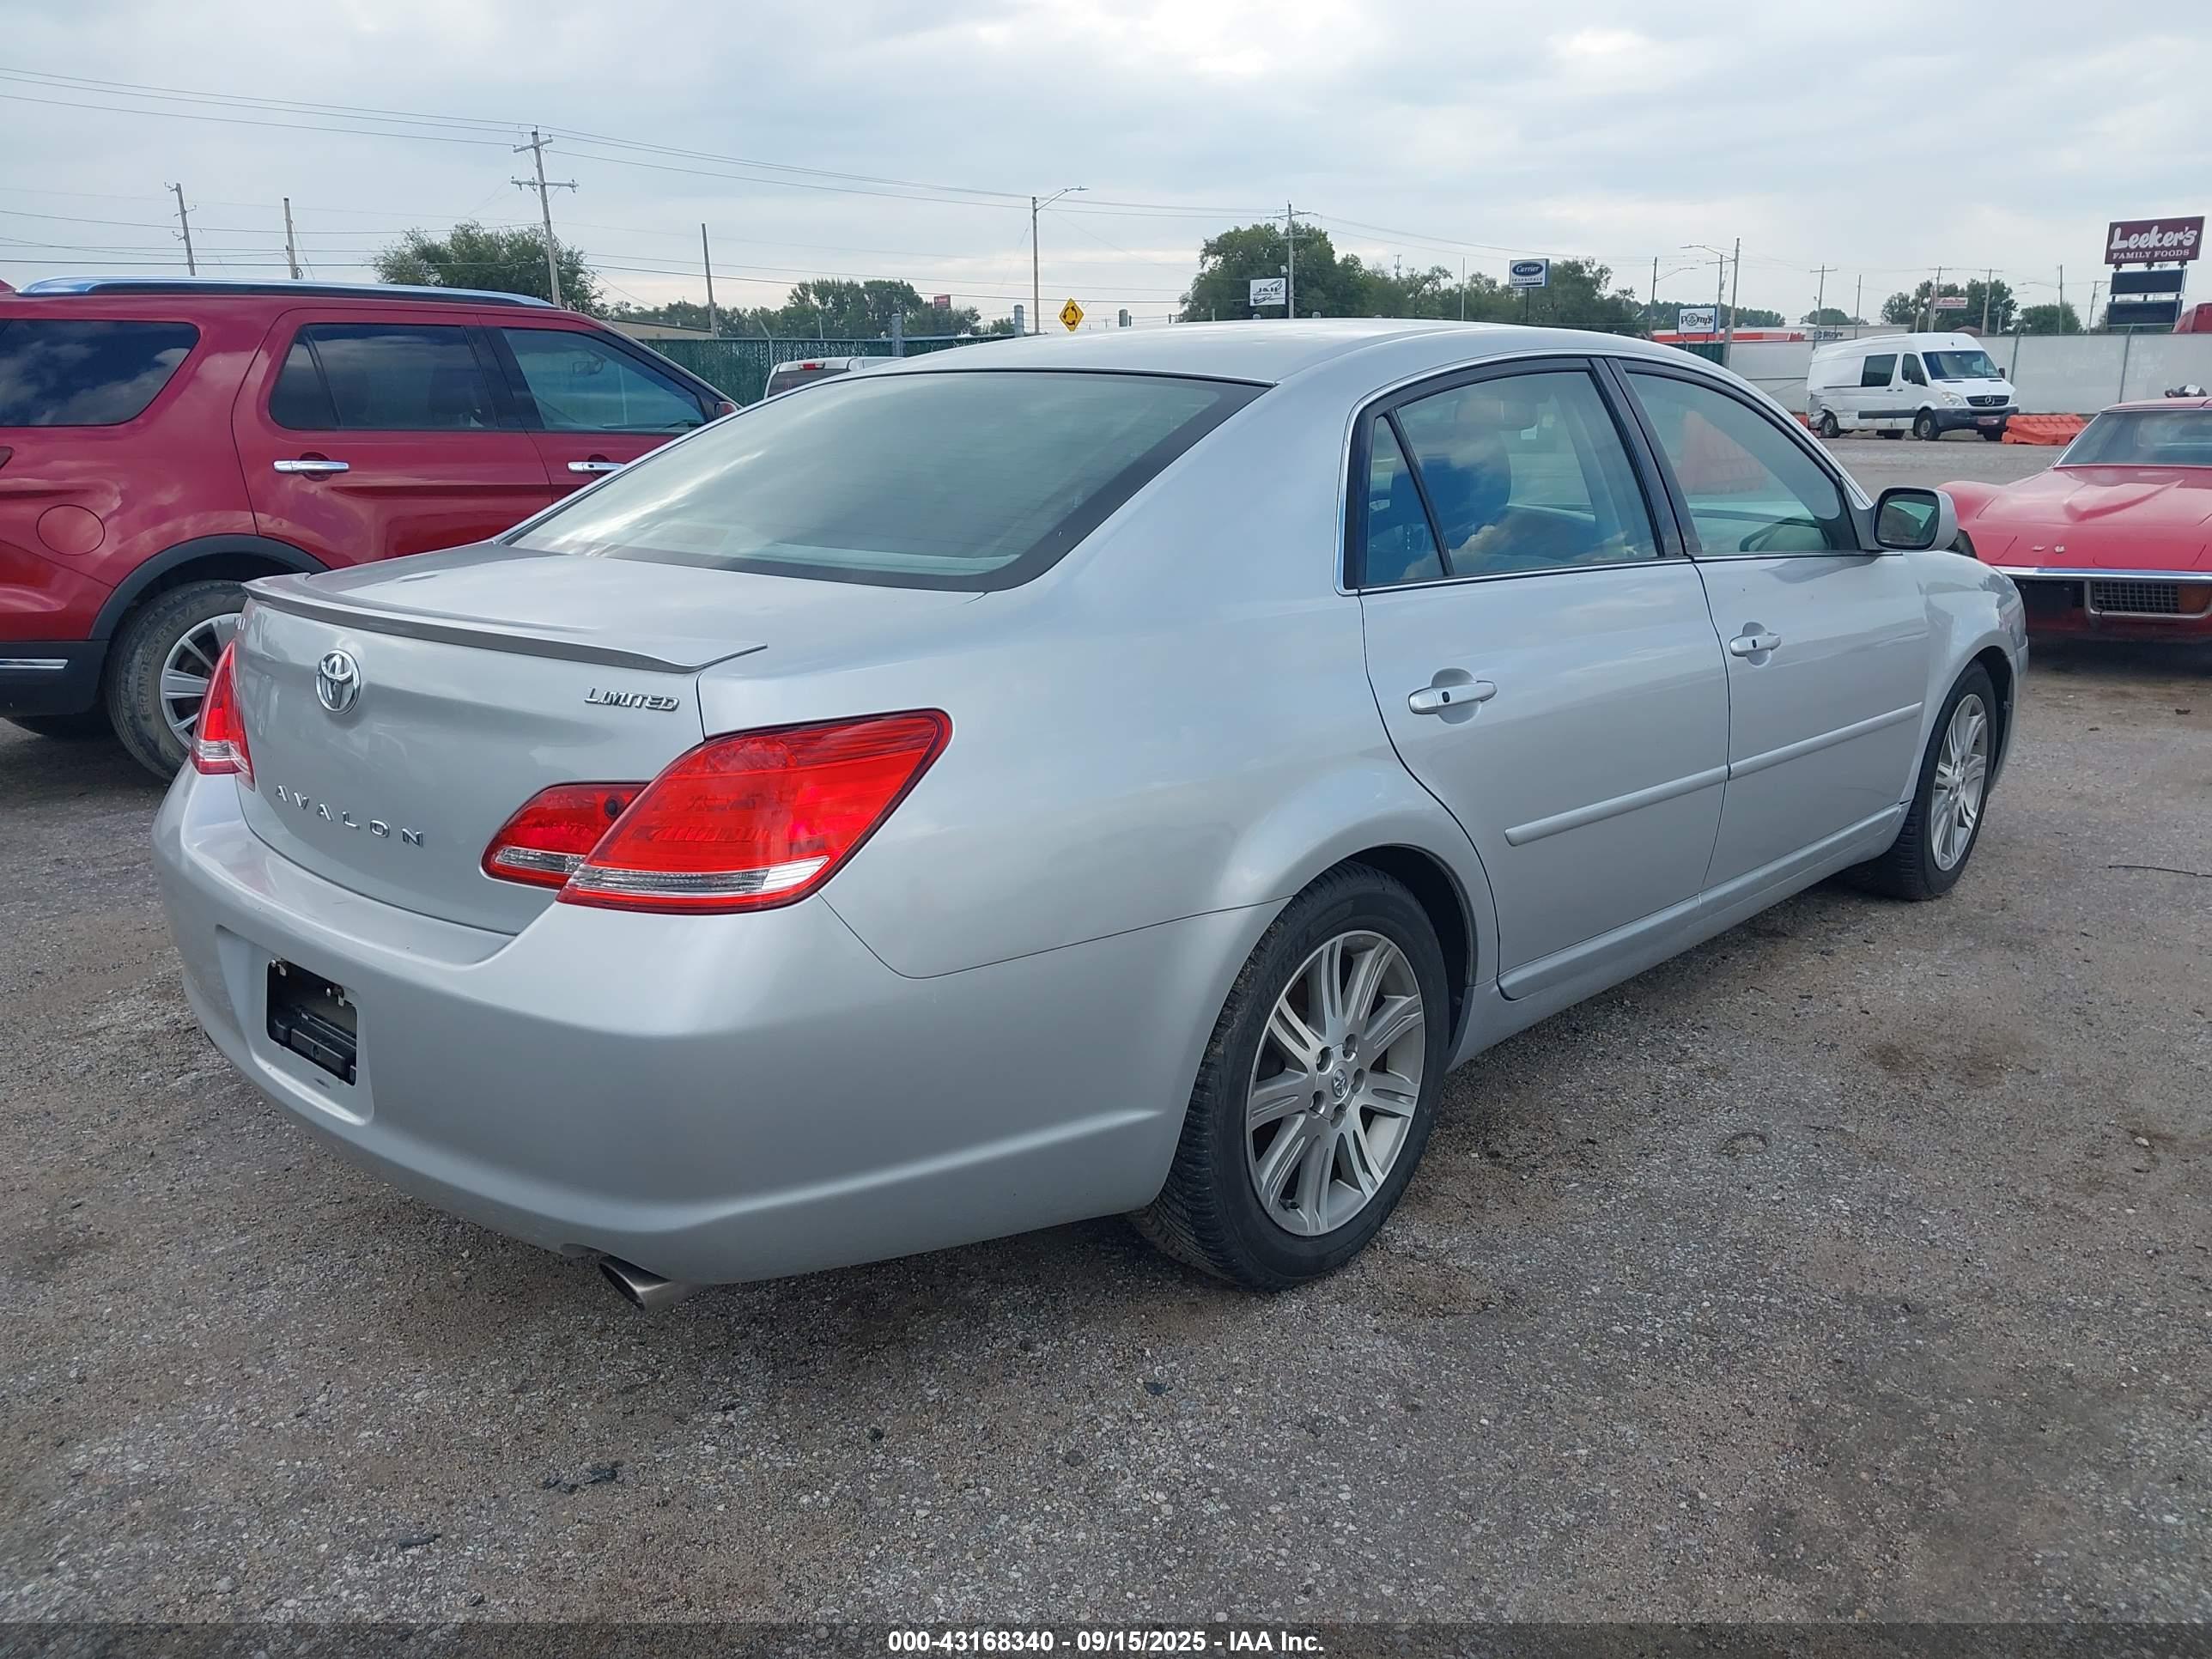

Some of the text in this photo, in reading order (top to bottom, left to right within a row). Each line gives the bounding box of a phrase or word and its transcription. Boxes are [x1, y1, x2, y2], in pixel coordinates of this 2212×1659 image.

[2110, 225, 2197, 250] Leeker's
[2112, 249, 2190, 259] FAMILY FOODS
[584, 687, 680, 712] LIMITED
[276, 785, 423, 848] AVALON
